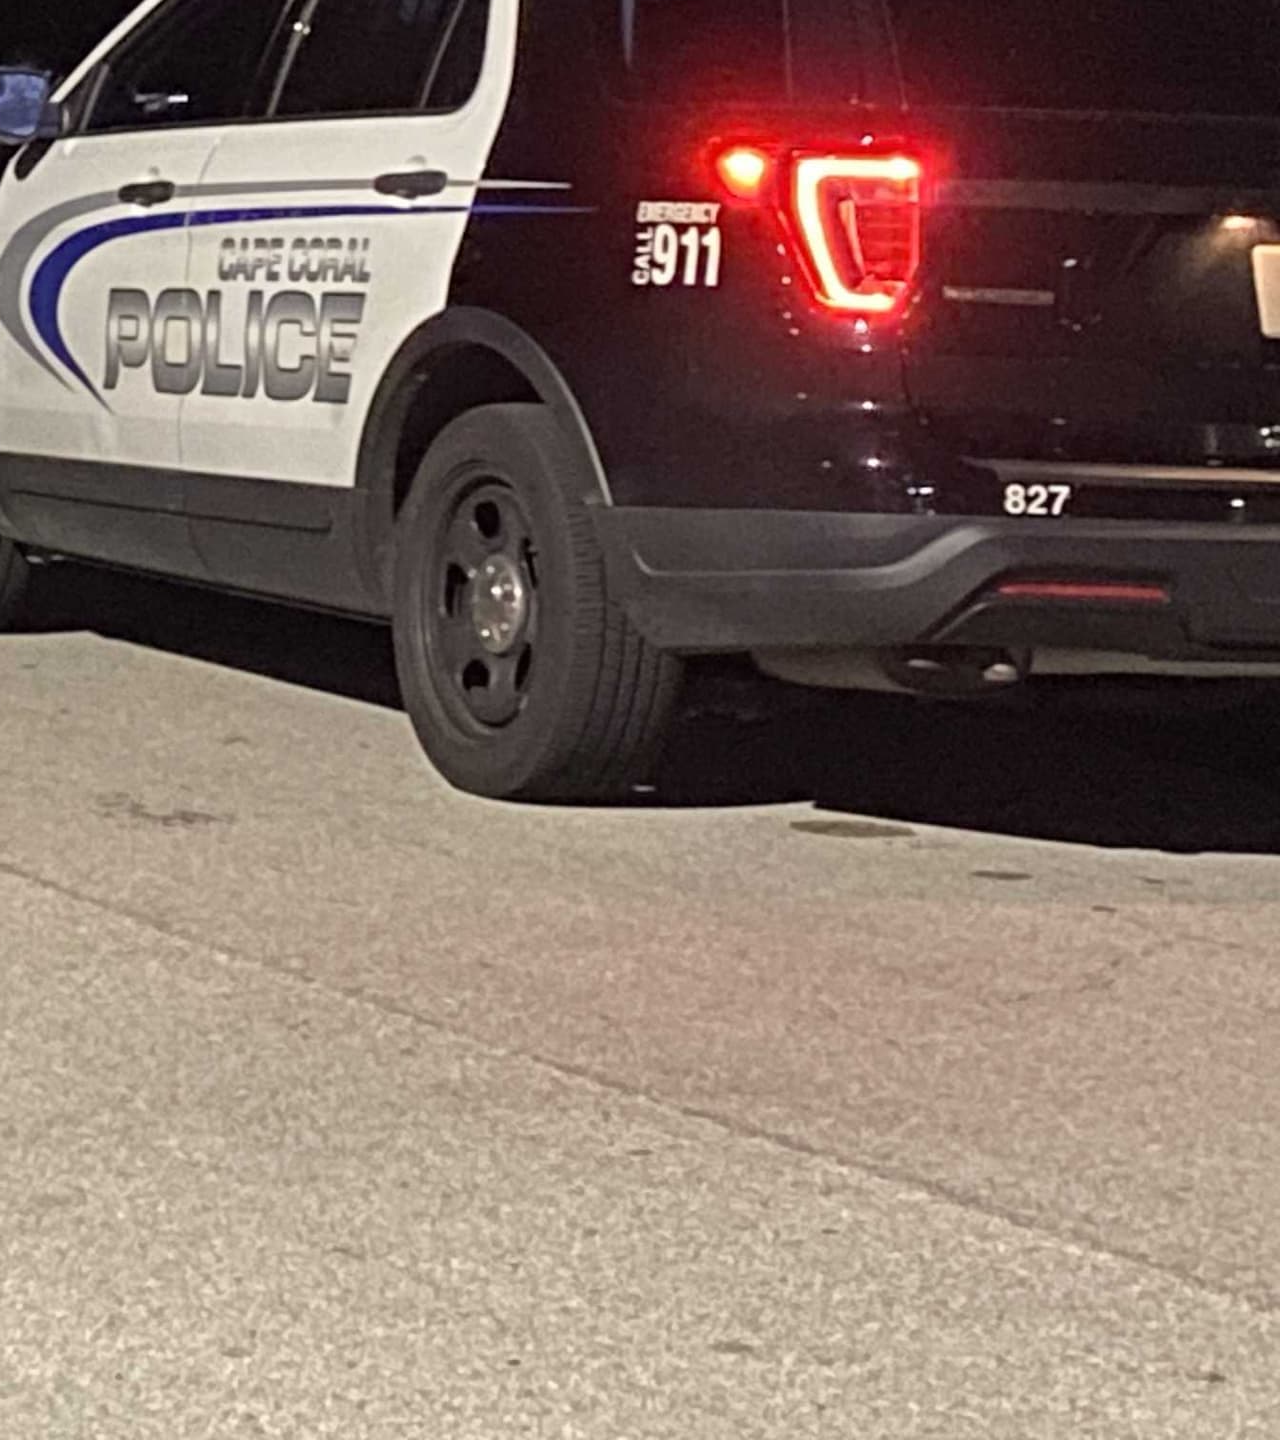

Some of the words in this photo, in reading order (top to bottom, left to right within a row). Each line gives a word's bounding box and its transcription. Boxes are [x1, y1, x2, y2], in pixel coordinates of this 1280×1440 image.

[218, 237, 285, 282] CAPE
[288, 237, 371, 283] CORAL
[631, 225, 654, 285] CALL
[651, 223, 721, 287] 911
[102, 287, 367, 404] POLICE
[1003, 483, 1071, 516] 827
